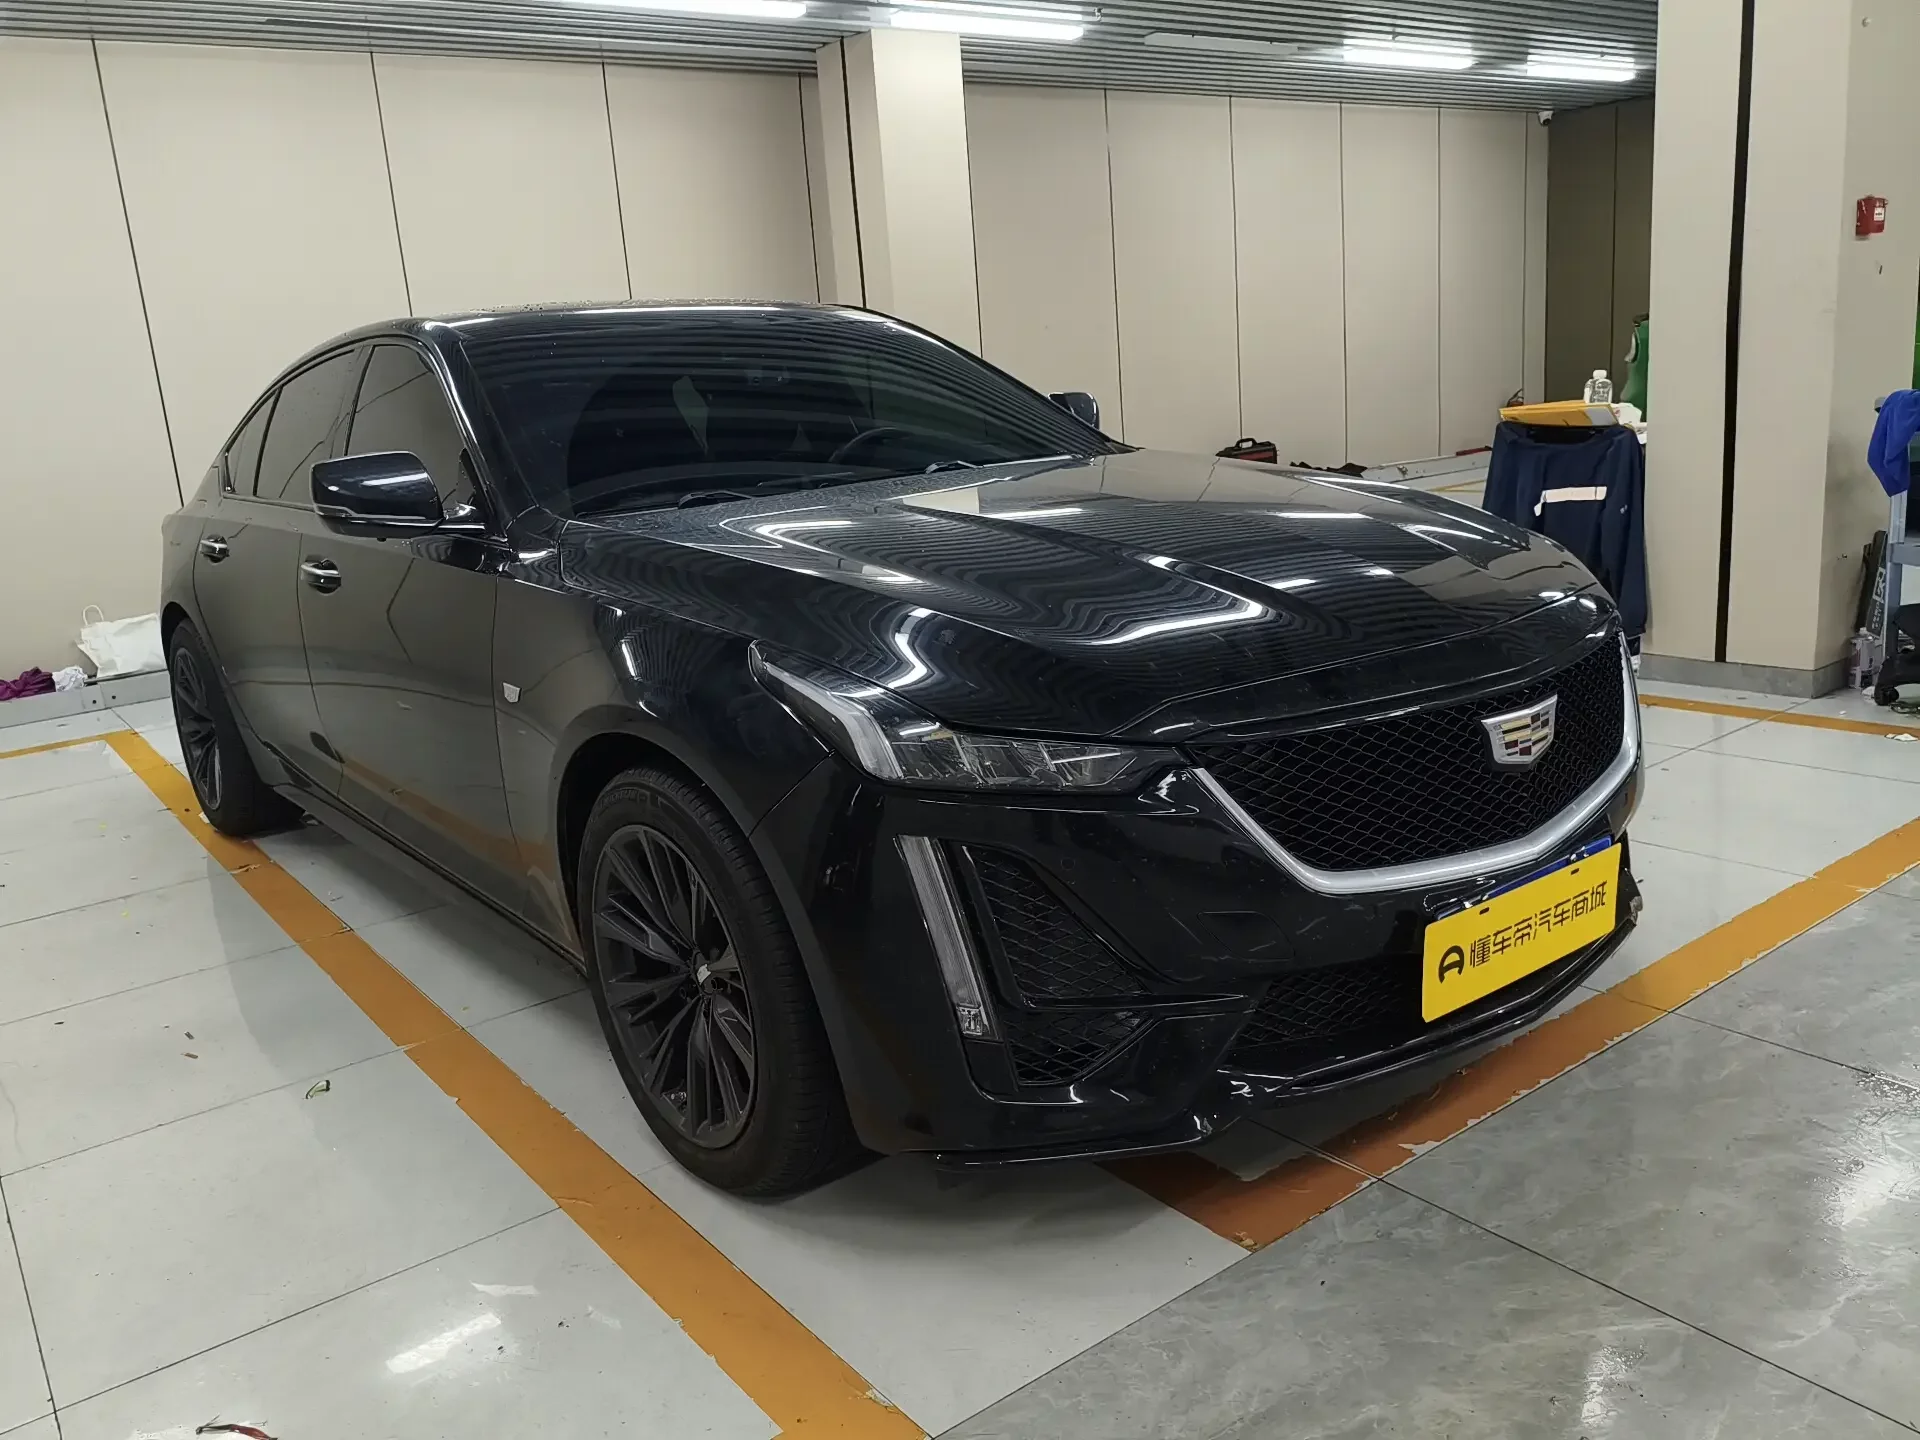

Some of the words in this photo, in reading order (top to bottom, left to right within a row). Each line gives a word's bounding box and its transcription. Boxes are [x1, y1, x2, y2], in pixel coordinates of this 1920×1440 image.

[1470, 880, 1607, 967] 懂车帝汽车商城
